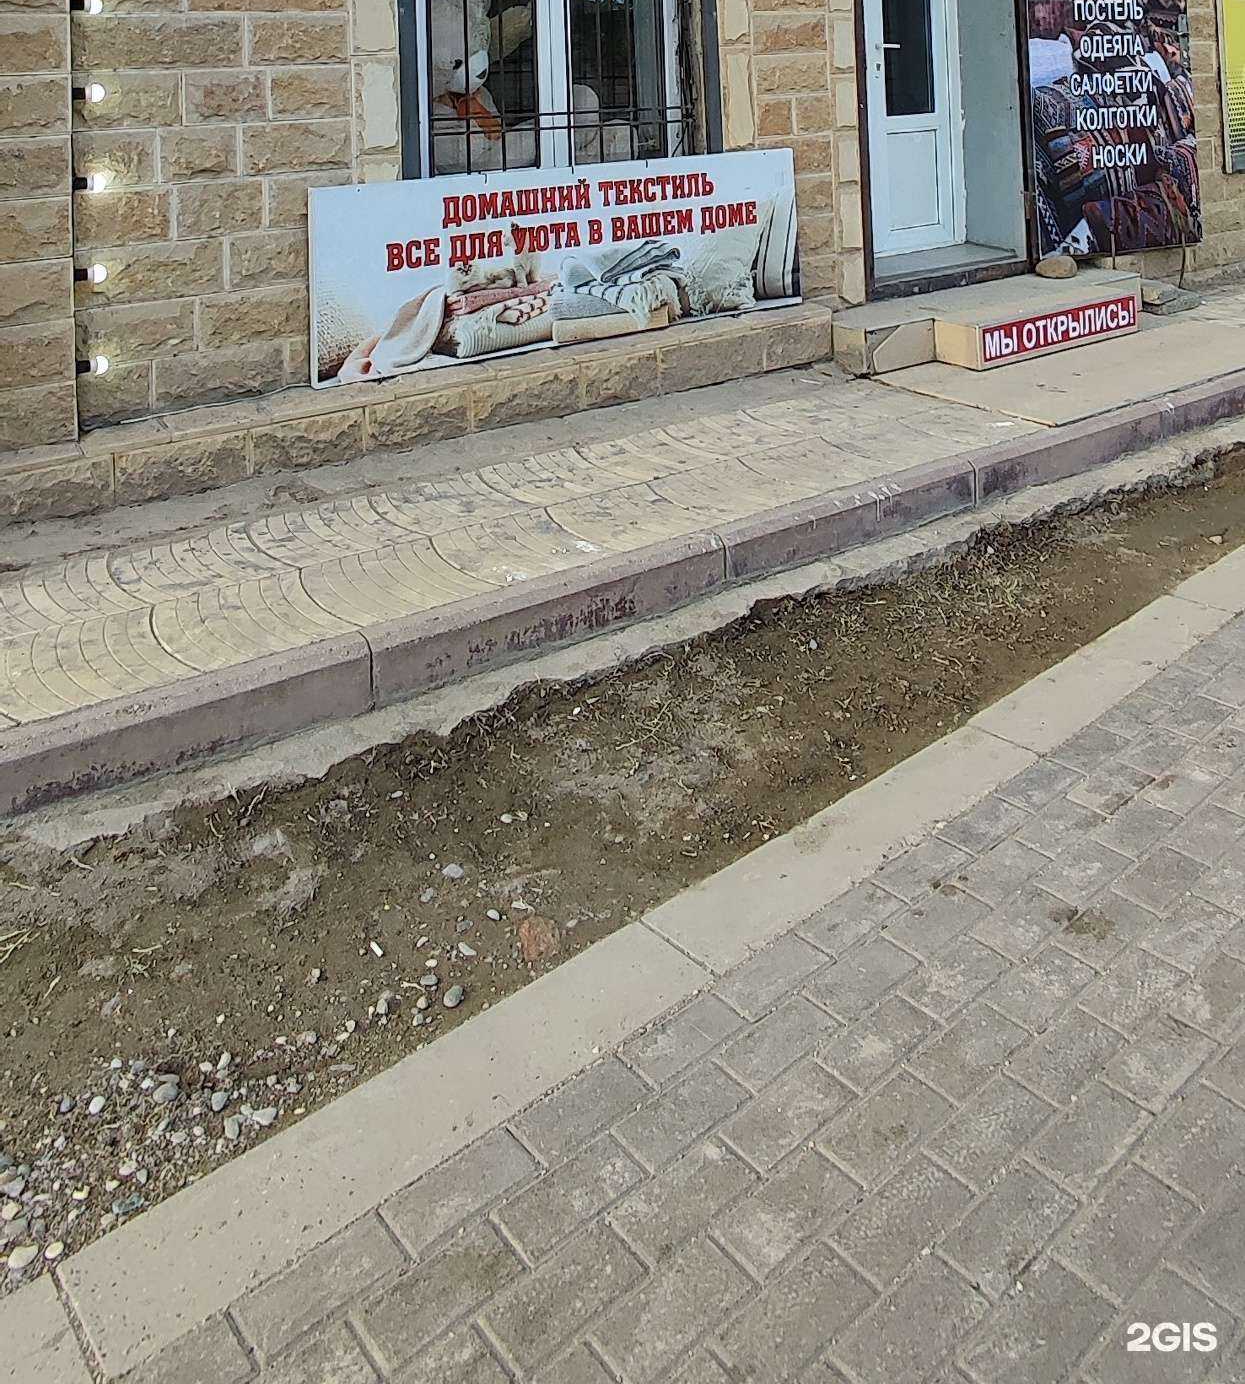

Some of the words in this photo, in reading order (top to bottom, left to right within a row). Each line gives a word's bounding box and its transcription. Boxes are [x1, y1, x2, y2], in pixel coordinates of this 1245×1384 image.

[1073, 0, 1144, 22] ПОСТЕЛЬ
[1079, 33, 1145, 59] ОДЕЯЛА
[1070, 71, 1153, 96] САЛФЕТКИ
[1076, 105, 1157, 131] КОЛГОТКИ
[1092, 143, 1148, 169] НОСКИ
[442, 179, 591, 228] ДОМАШНИЙ
[598, 172, 715, 207] ТЕКСТИЛЬ
[386, 239, 440, 272] ВСЕ
[449, 231, 504, 267] ДЛЯ
[512, 220, 580, 256] УЮТА
[588, 219, 602, 242] В
[612, 209, 693, 241] ВАШЕМ
[700, 201, 758, 232] ДОМЕ
[985, 327, 1018, 358] МЫ
[1022, 300, 1135, 349] ОТКРЫЛИСЬ!
